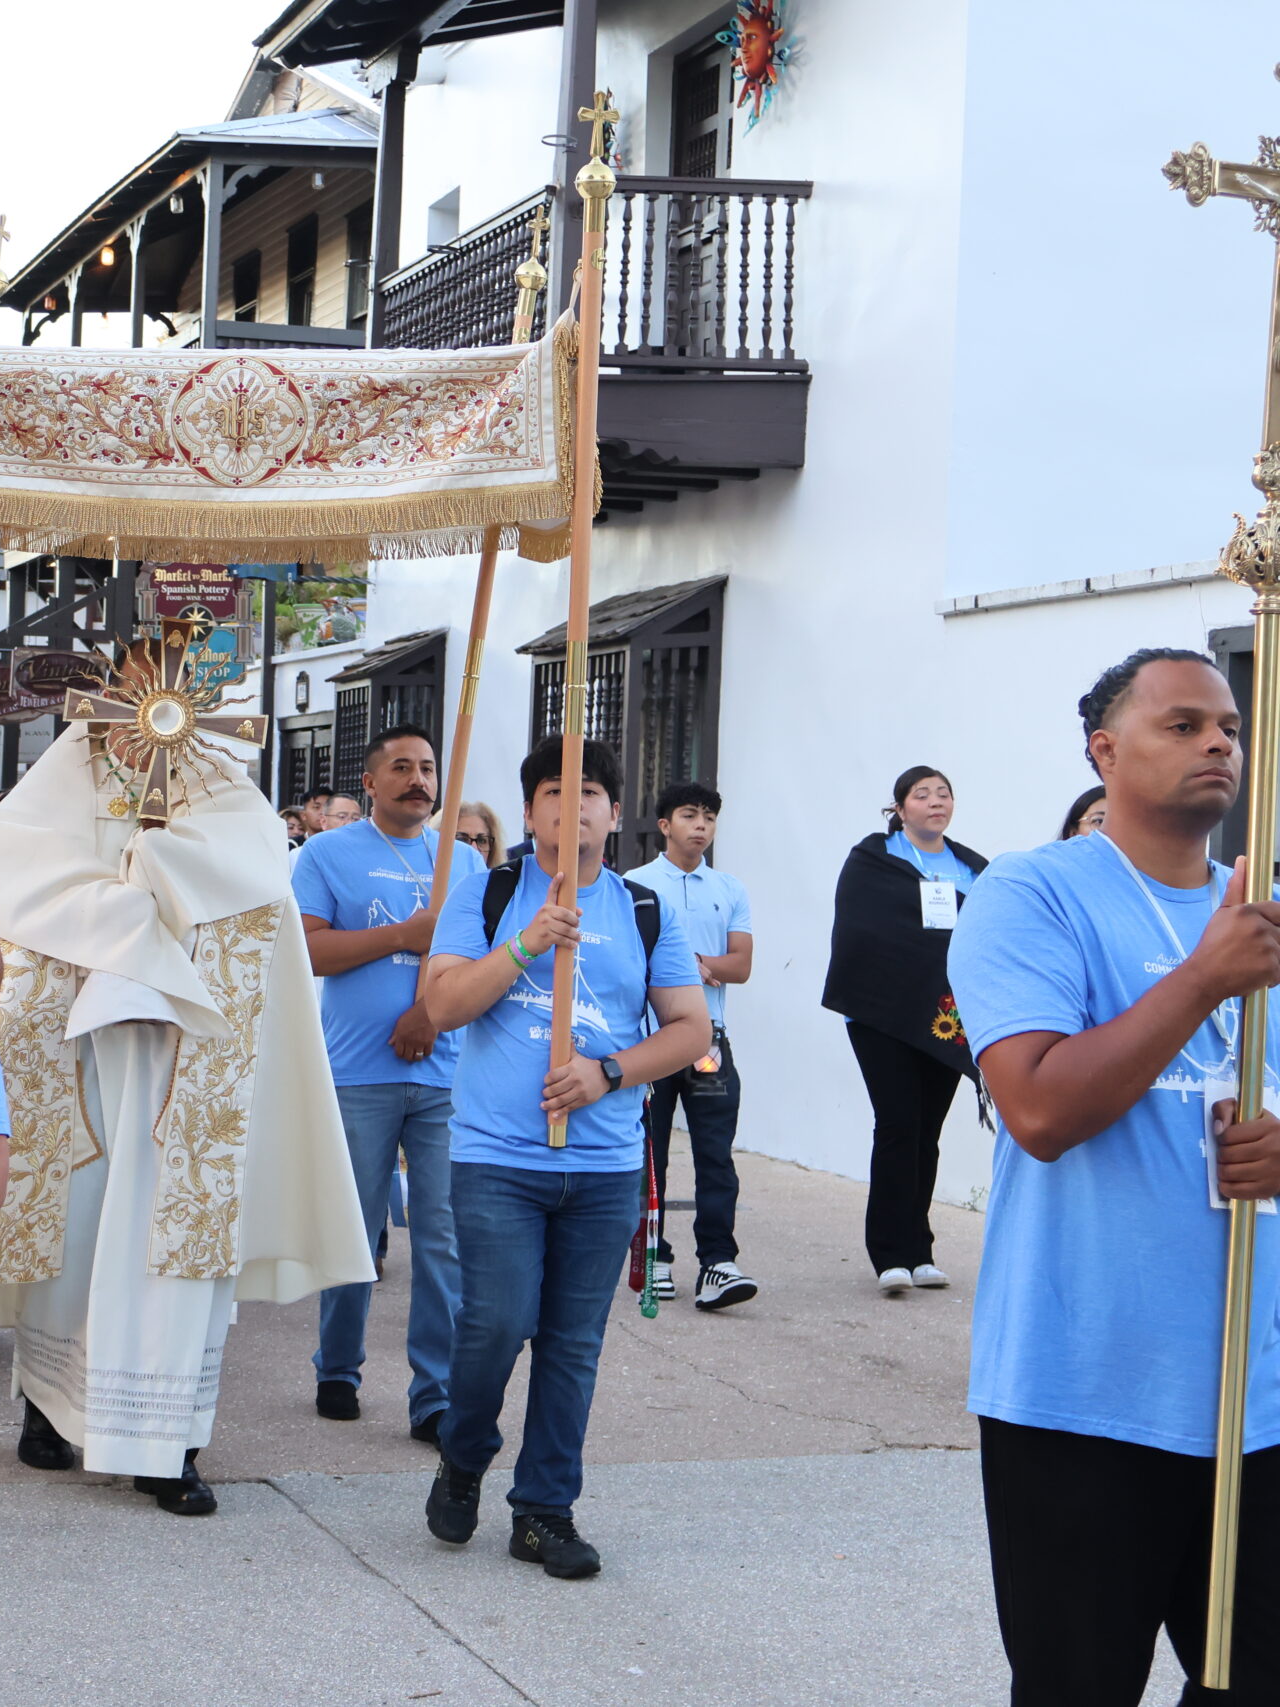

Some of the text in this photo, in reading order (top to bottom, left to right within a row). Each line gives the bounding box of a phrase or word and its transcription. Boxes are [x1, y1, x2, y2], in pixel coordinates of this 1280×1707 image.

[200, 568, 234, 583] Mark
[161, 584, 231, 596] Spanish Pottery
